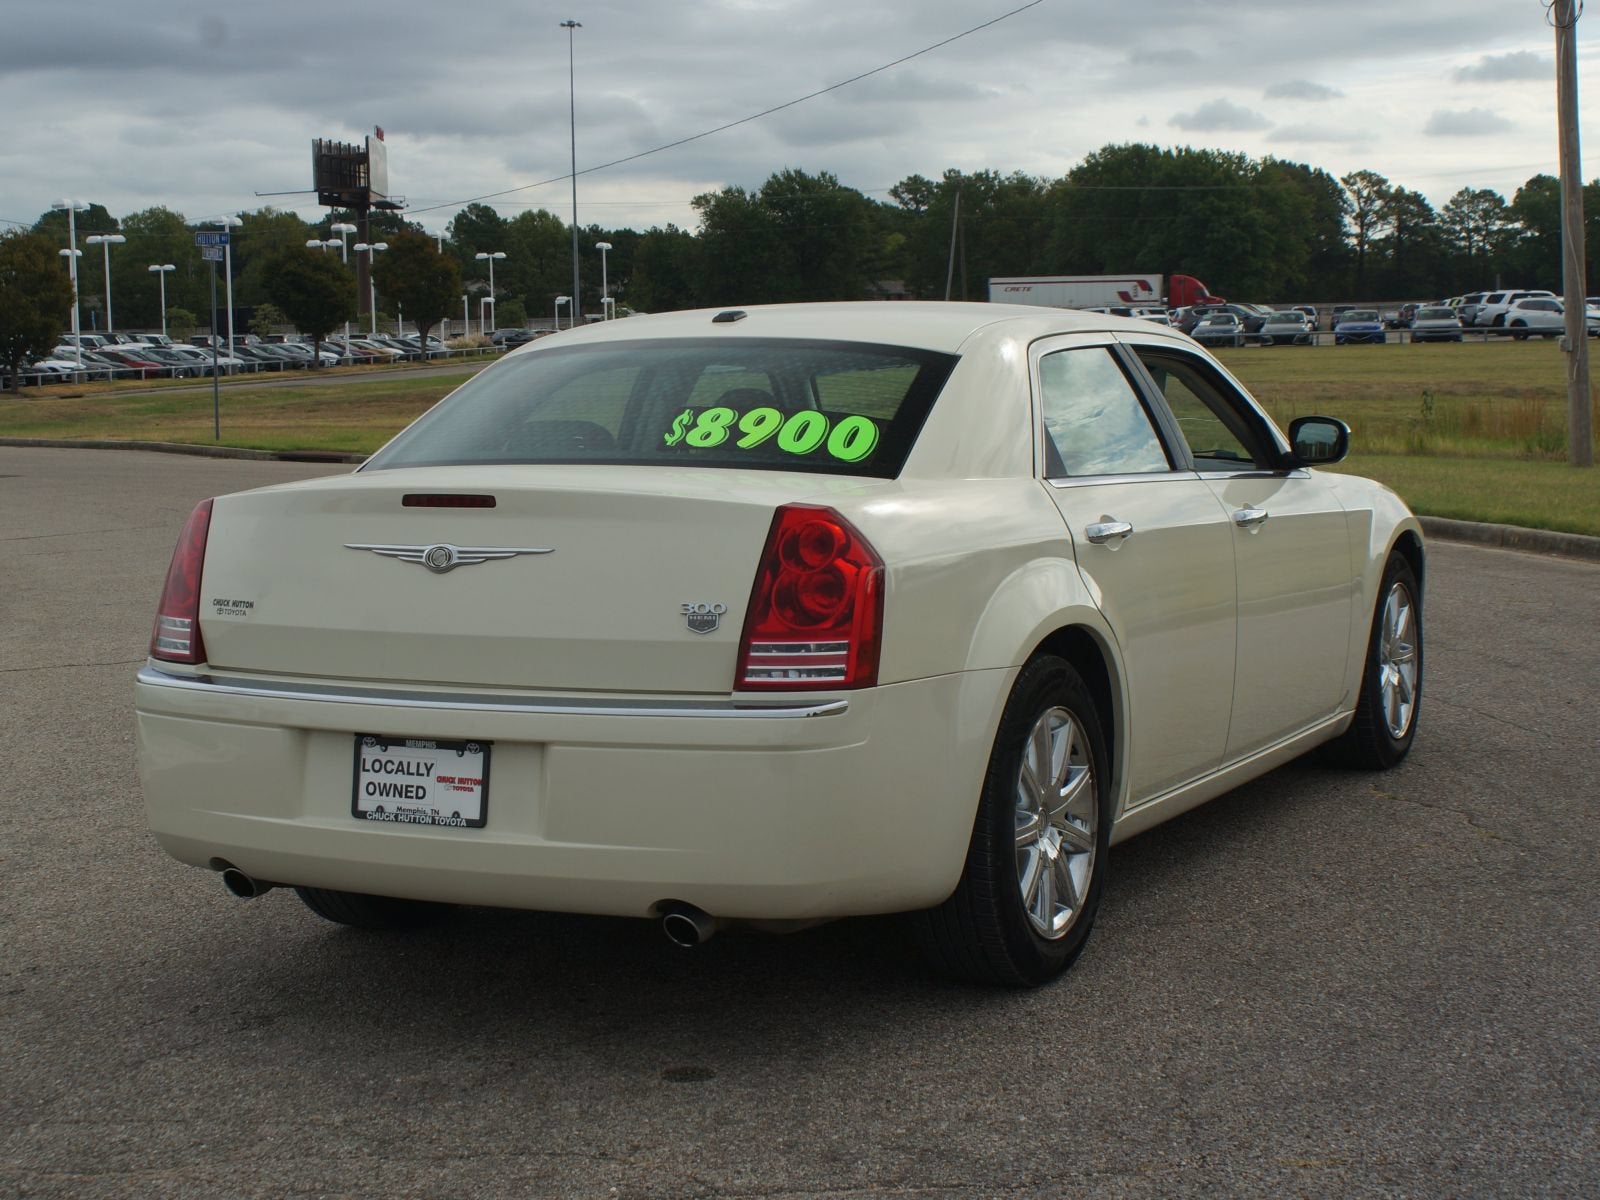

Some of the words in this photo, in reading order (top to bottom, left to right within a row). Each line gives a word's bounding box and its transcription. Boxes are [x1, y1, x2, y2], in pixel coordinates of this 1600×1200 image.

[664, 407, 880, 463] $8900
[212, 598, 230, 607] CHUCK
[231, 600, 254, 609] HUTTON
[680, 602, 728, 614] 300
[224, 608, 247, 616] TOYOTA
[405, 739, 437, 750] MEMPHIS
[361, 757, 435, 778] LOCALLY
[436, 775, 456, 785] CHUCK
[365, 781, 427, 801] OWNED
[452, 785, 474, 793] TOYOTA
[430, 808, 440, 816] TN
[366, 811, 397, 821] CHUCK
[398, 814, 432, 825] HUTTON
[435, 816, 467, 827] TOYOTA
